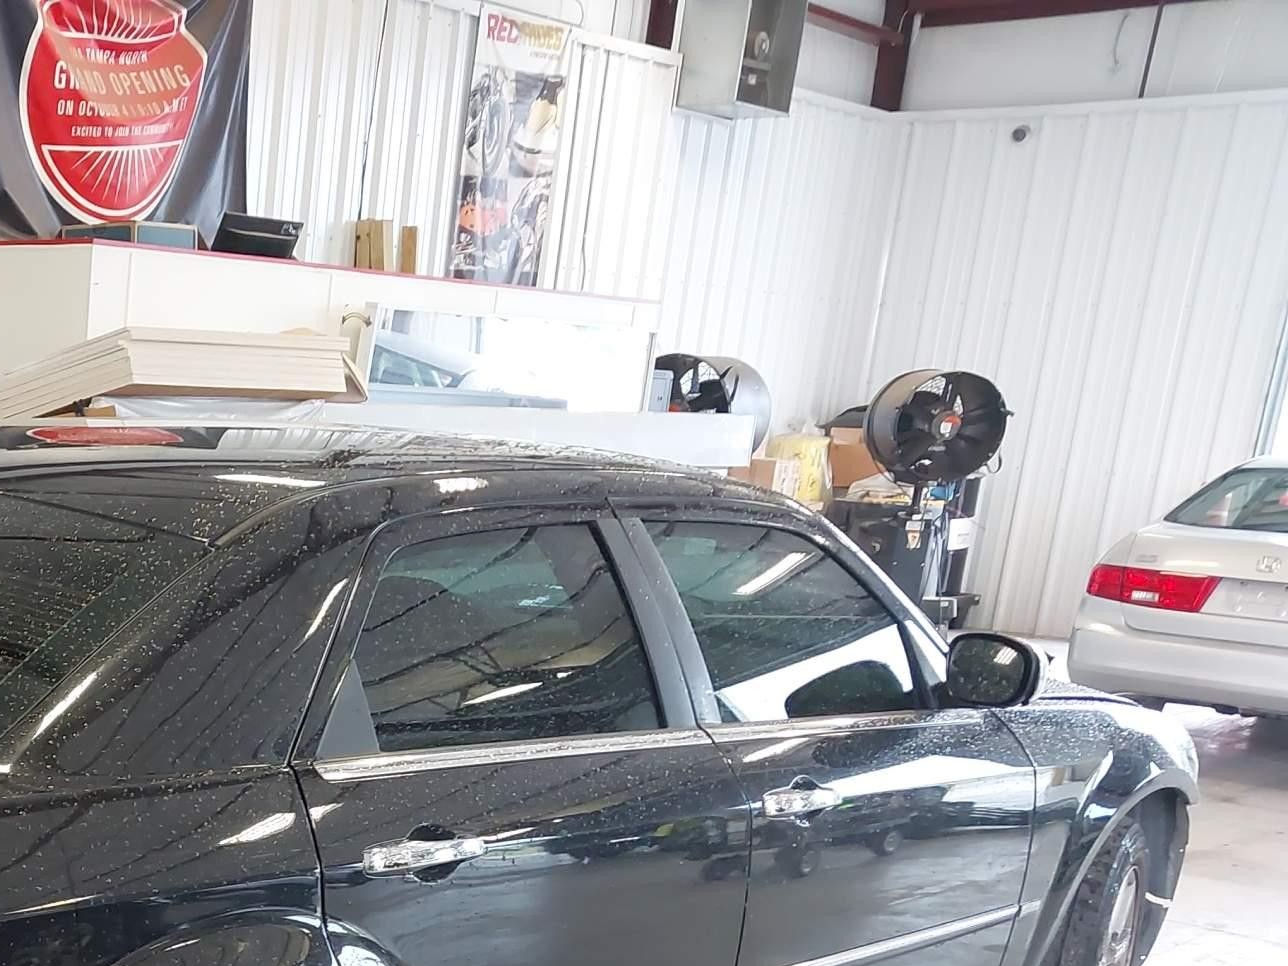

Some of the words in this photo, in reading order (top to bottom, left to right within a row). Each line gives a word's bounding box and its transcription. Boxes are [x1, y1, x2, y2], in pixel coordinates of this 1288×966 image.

[85, 47, 116, 64] TAMPA
[54, 59, 106, 95] GRAND
[109, 64, 190, 95] OPENING
[57, 99, 74, 116] ON
[71, 125, 102, 138] EXCITED
[104, 126, 113, 138] TO
